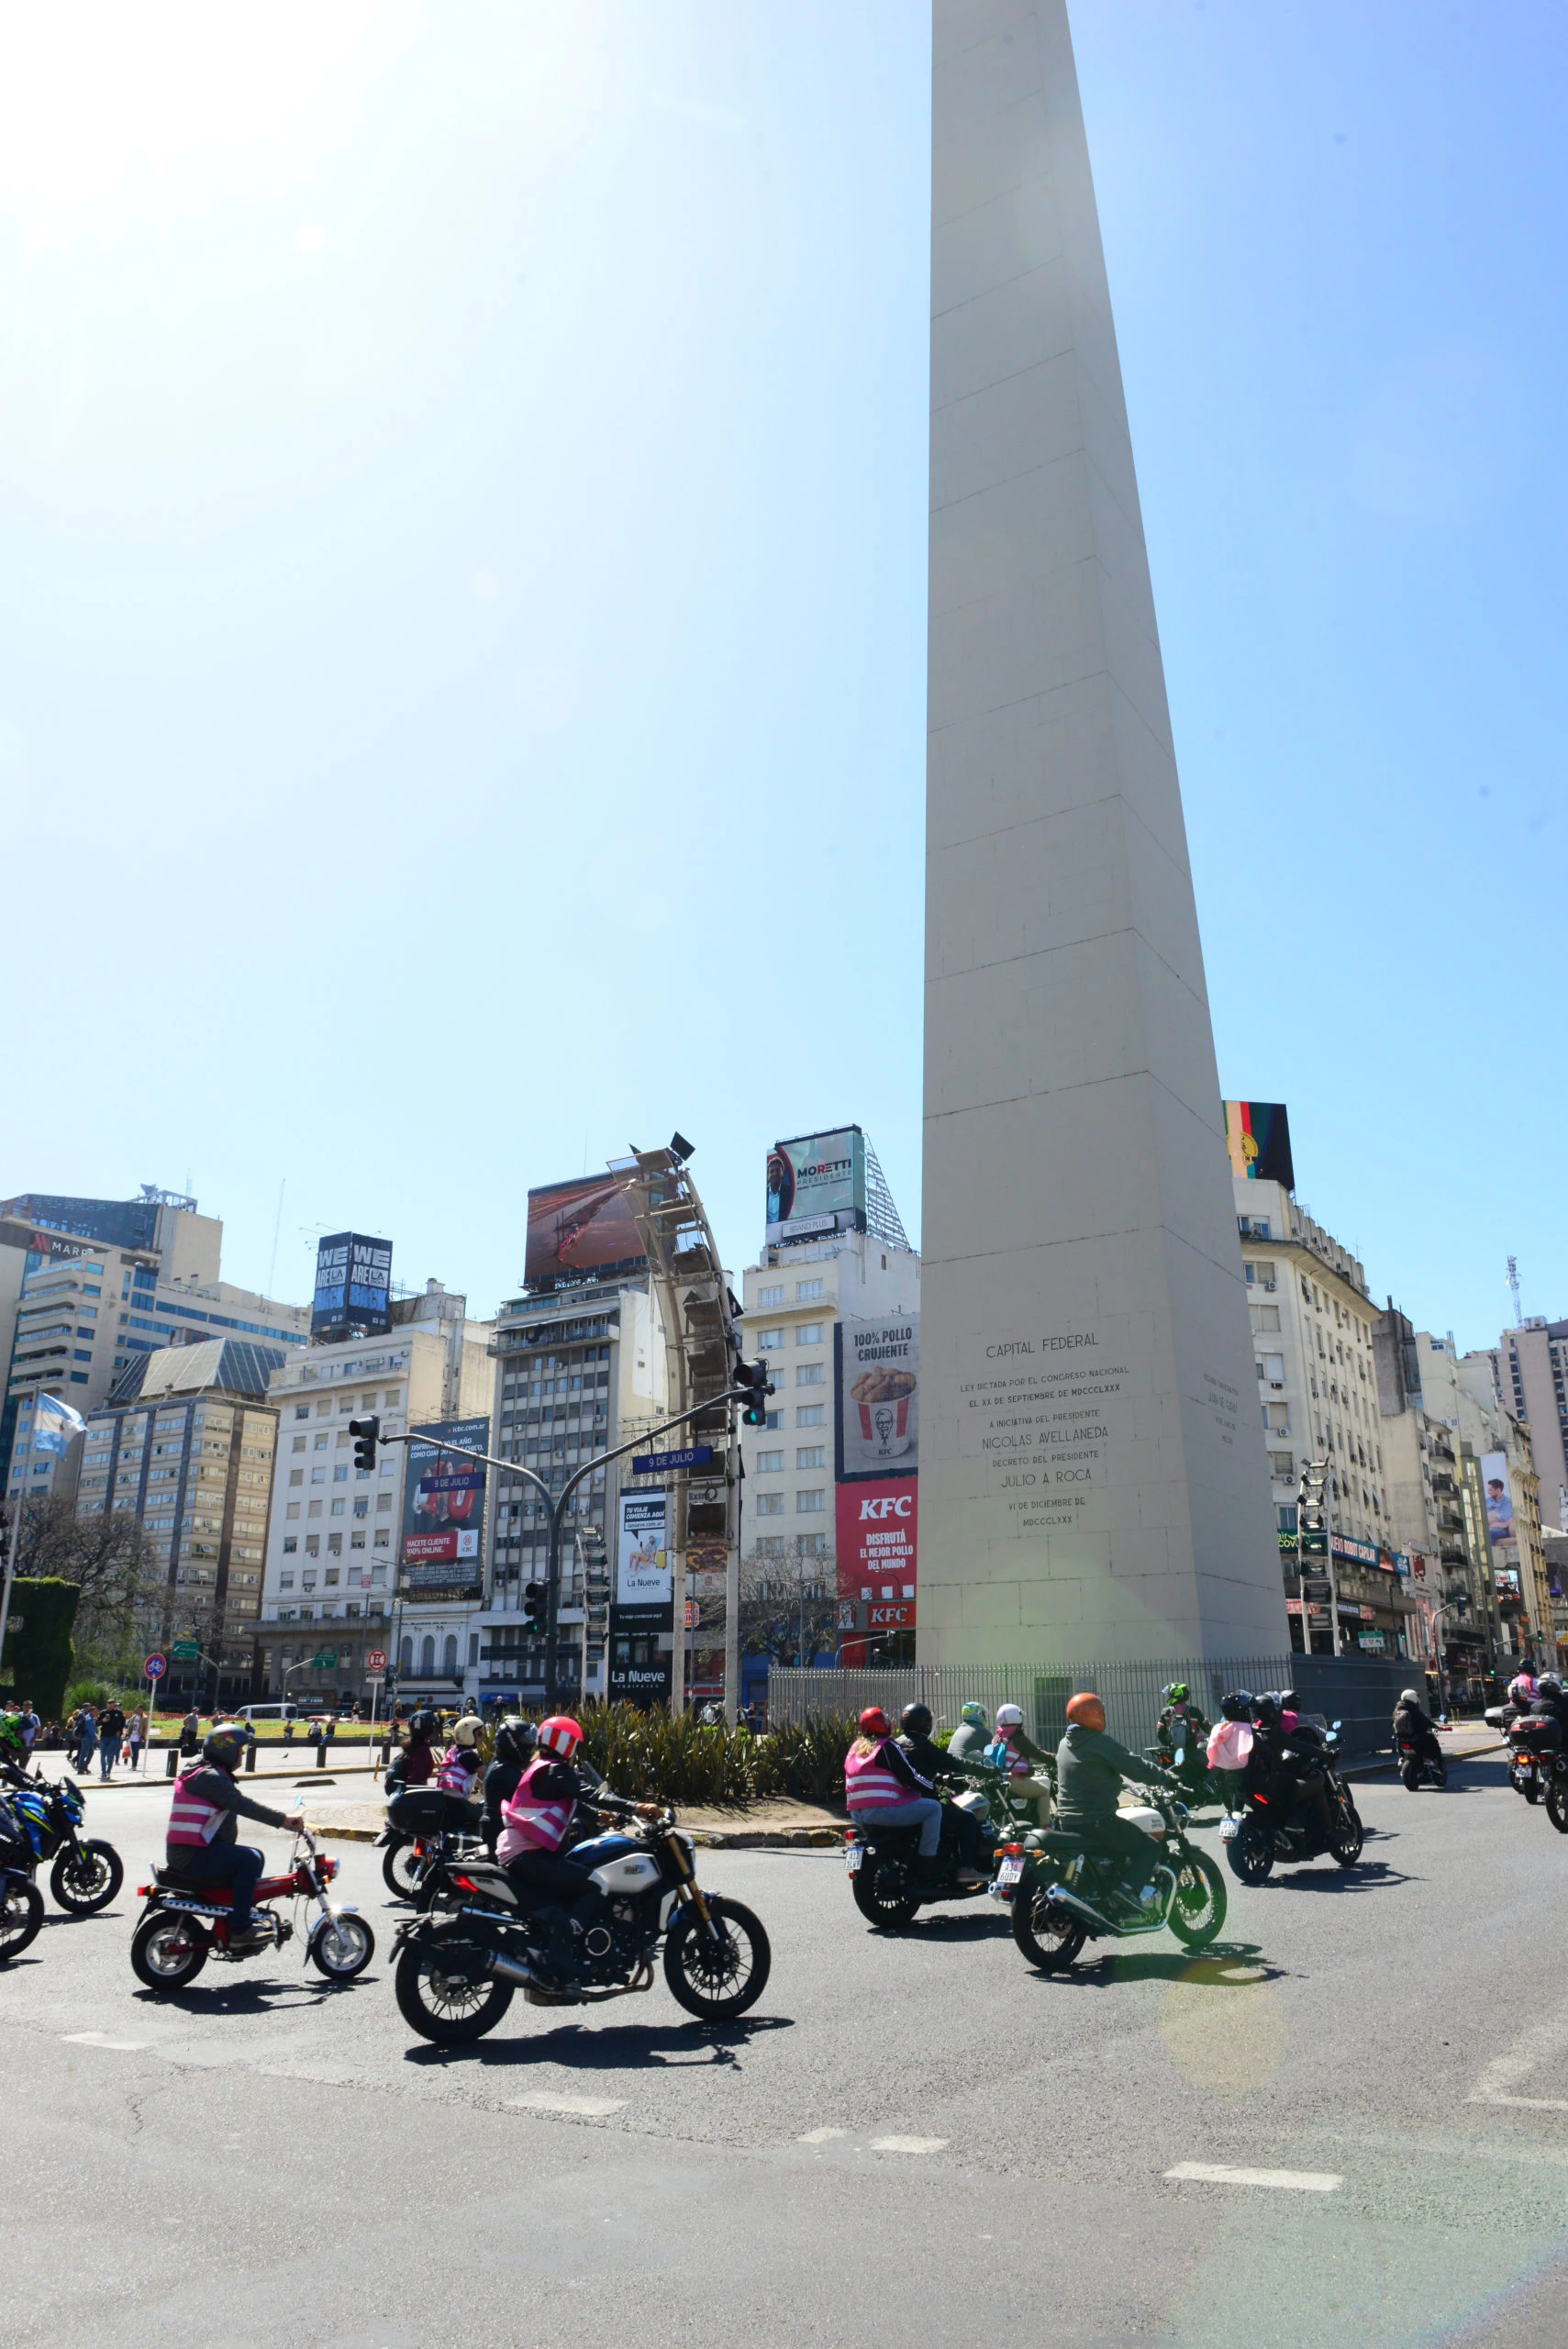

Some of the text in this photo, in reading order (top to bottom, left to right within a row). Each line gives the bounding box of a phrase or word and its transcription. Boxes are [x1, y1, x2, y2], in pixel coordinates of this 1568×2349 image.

[797, 1159, 851, 1178] MORETTI
[797, 1170, 851, 1185] PRESIDENTE
[790, 1219, 828, 1233] BRAND PLUS
[318, 1246, 348, 1268] WE
[353, 1244, 390, 1268] WE
[316, 1268, 329, 1288] ARE
[350, 1264, 369, 1285] ARE
[349, 1284, 387, 1311] BACK
[854, 1327, 912, 1347] 100% POLLO
[986, 1332, 1099, 1358] CAPITAL FEDERAL
[858, 1343, 908, 1362] CRUJIENTE
[961, 1365, 1129, 1393] LEY DICTADA POR EL CONGRESO NACIONAL
[995, 1397, 1005, 1405] DE
[1007, 1391, 1055, 1404] SEPTIEMBRE
[1058, 1389, 1069, 1397] DE
[1072, 1384, 1121, 1397] MDCCCLXXX
[996, 1417, 1033, 1427] INICIATIVA
[1036, 1414, 1050, 1423] DEL
[1052, 1408, 1100, 1421] PRESIDENTE
[452, 1423, 485, 1433] icbc.com.ar
[459, 1437, 472, 1445] AÑO
[982, 1426, 1108, 1450] NICOLAS AVELLANEDA
[410, 1451, 426, 1459] COMO
[649, 1452, 694, 1467] 9 DE JULIO
[992, 1450, 1099, 1468] DECRETO DEL PRESIDENTE
[434, 1476, 470, 1488] 9 DE JULIO
[1001, 1468, 1092, 1488] JULIO A. ROCA
[859, 1496, 912, 1520] KFC
[1008, 1497, 1085, 1511] VI DE DICIEMBRE DE
[1023, 1516, 1073, 1527] MDCCCLXXX
[406, 1537, 450, 1548] HACETE CLIENTE
[866, 1529, 906, 1546] DISFRUTÁ
[422, 1546, 445, 1554] ONLINE.
[860, 1545, 914, 1558] EL MEJOR POLLO
[1330, 1535, 1375, 1563] UEVO ROBOT CAPILAR
[868, 1558, 906, 1570] DEL MUNDO
[627, 1577, 661, 1587] La Nueve
[871, 1608, 908, 1623] KFC
[611, 1670, 665, 1683] La Nueve
